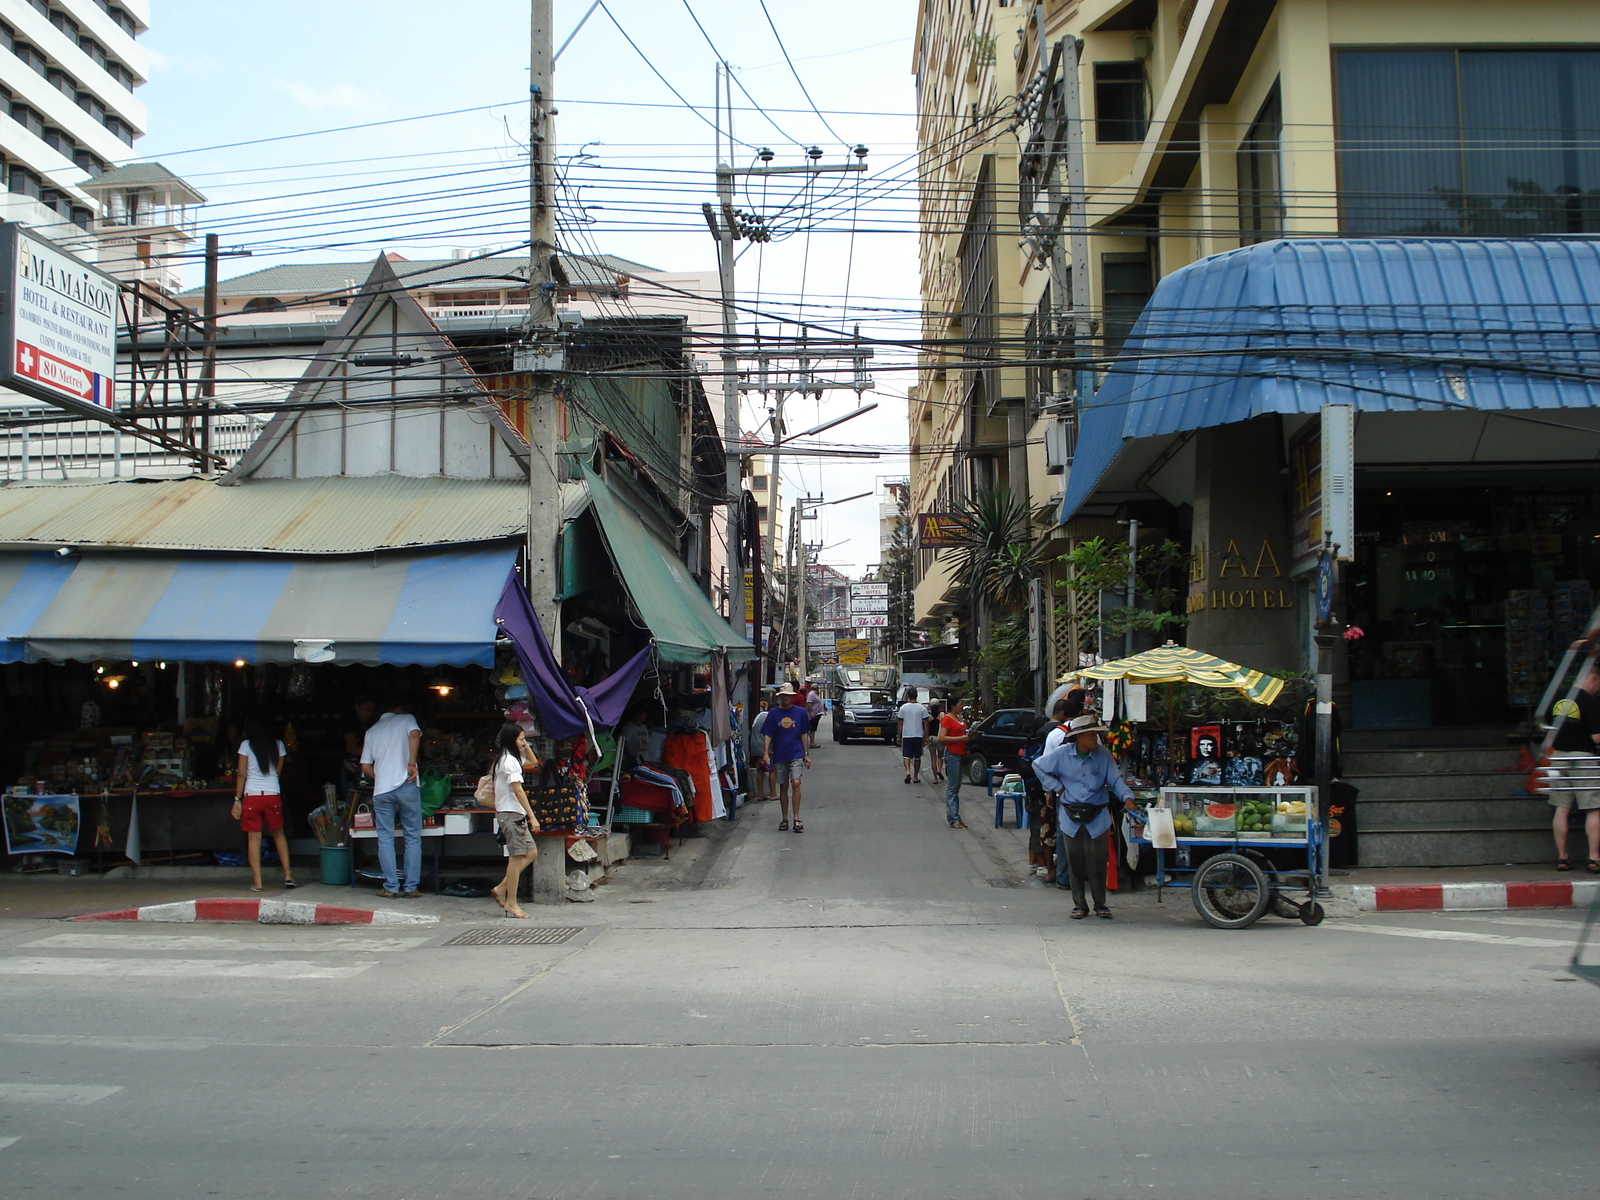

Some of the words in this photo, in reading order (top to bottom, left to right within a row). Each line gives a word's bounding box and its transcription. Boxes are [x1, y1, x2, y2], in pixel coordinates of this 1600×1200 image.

[31, 253, 55, 287] MA
[59, 268, 112, 315] MAISON
[23, 286, 49, 311] HOTEL
[51, 301, 58, 315] &
[60, 304, 108, 338] RESTAURANT
[19, 307, 42, 326] CHAMBRES
[42, 318, 58, 334] PISCINE
[59, 325, 73, 340] ROOMS
[73, 332, 81, 345] AND
[81, 335, 102, 353] SWIMMING
[101, 344, 111, 358] POOL
[39, 333, 56, 350] CUISINE
[43, 360, 57, 378] 80
[59, 368, 83, 389] Metres
[1218, 539, 1282, 578] AA
[1212, 589, 1294, 609] HOTEL
